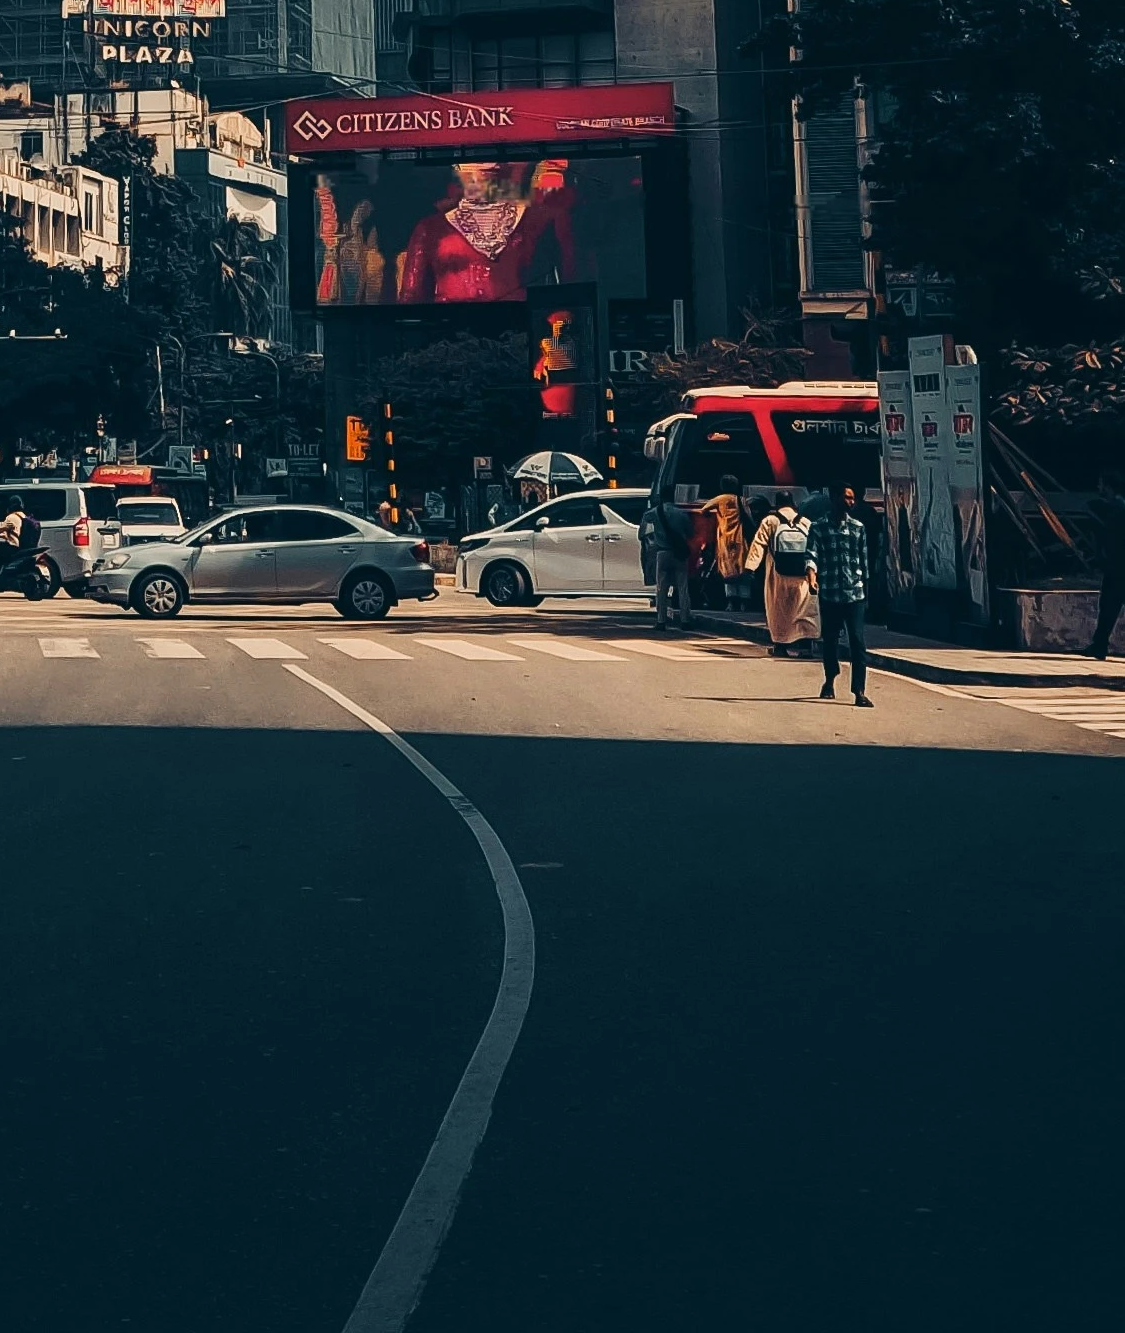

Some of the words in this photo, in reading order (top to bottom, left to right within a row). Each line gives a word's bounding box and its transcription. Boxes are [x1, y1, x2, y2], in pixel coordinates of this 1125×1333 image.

[83, 19, 211, 39] UNICORN
[102, 44, 194, 64] PLAZA
[336, 109, 443, 135] CITIZENS
[448, 106, 515, 131] BANK
